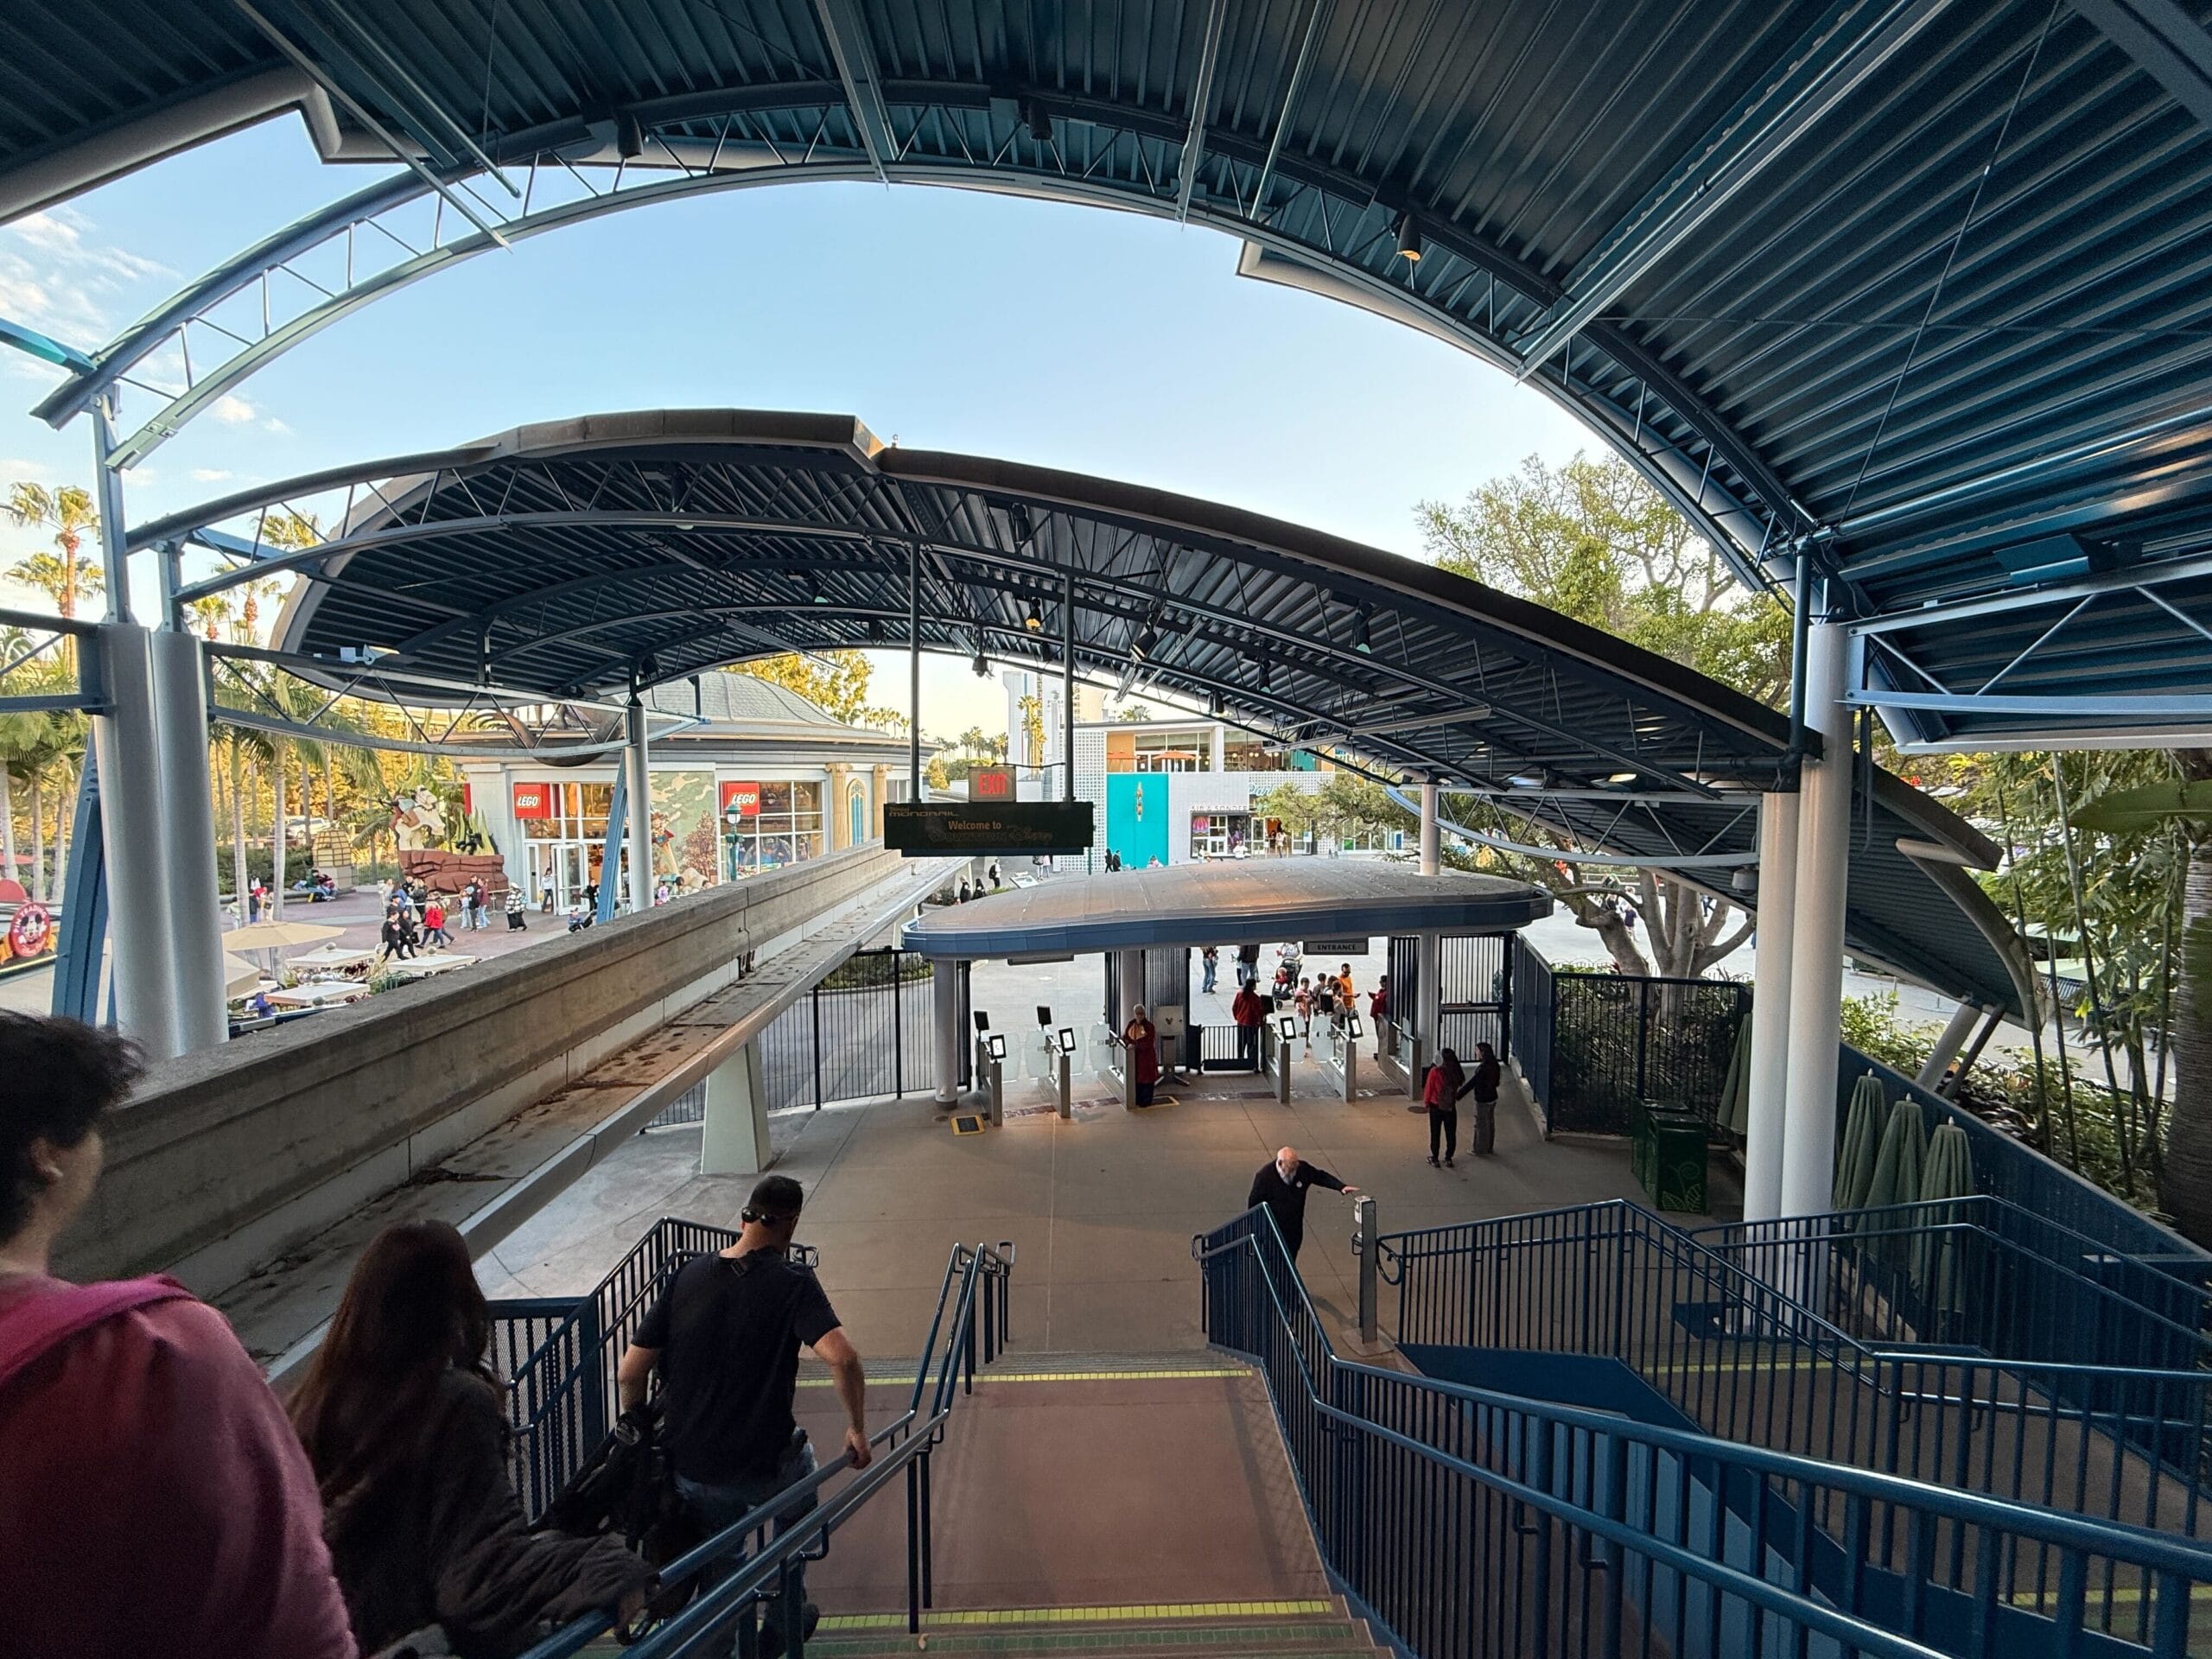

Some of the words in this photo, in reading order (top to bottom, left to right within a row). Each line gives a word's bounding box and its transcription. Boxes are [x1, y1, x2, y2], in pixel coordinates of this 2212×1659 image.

[978, 773, 1007, 795] EXIT
[518, 795, 539, 808] LEGO
[731, 793, 756, 805] LEGO
[948, 820, 990, 830] Welcome
[992, 820, 1002, 830] to
